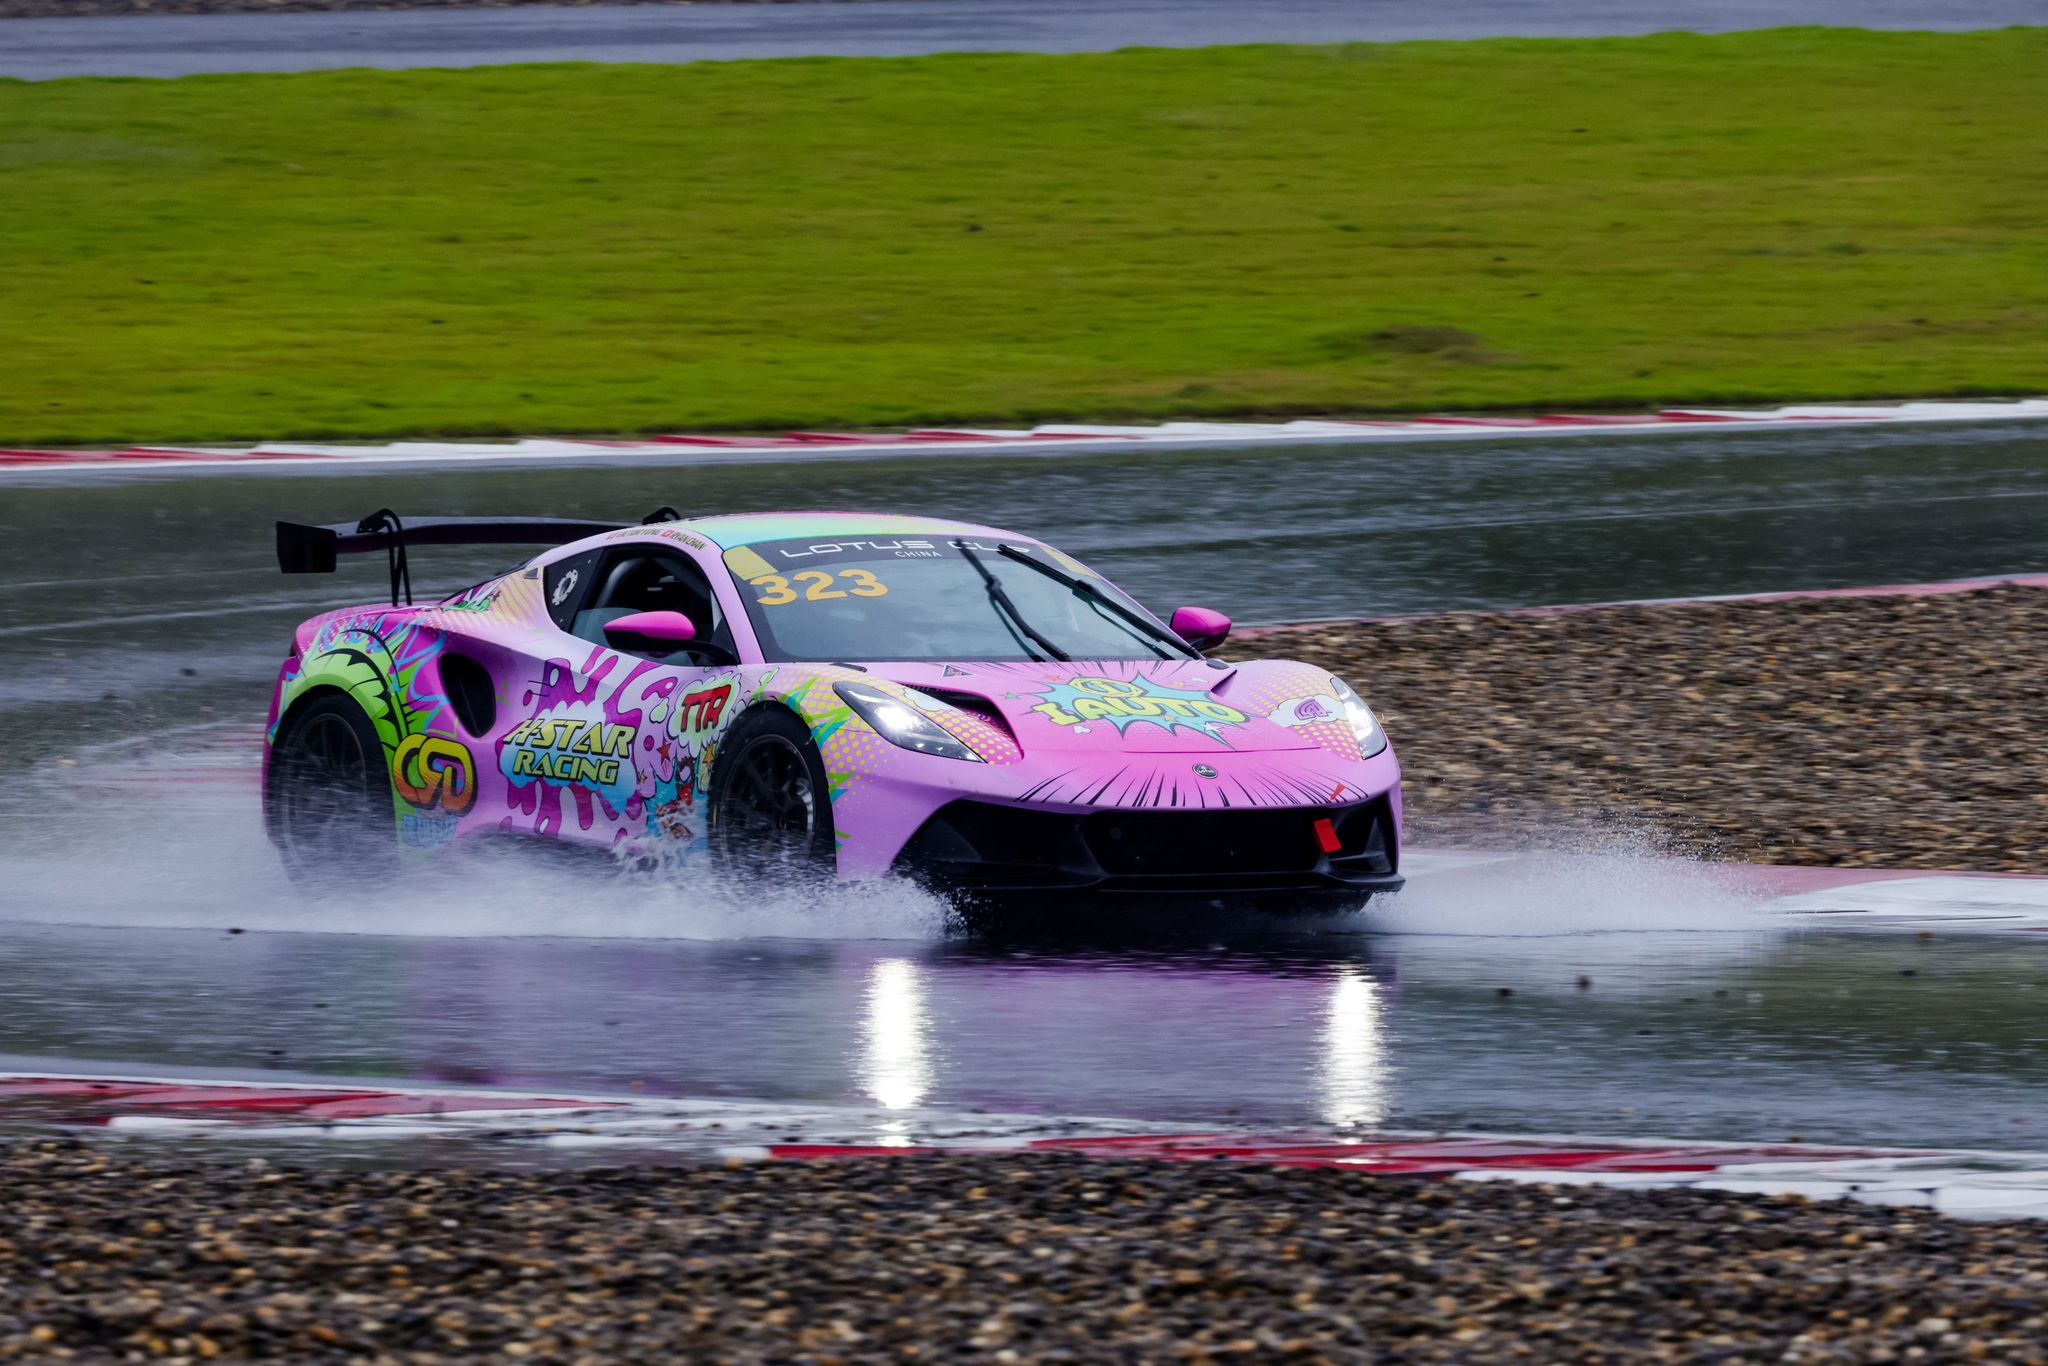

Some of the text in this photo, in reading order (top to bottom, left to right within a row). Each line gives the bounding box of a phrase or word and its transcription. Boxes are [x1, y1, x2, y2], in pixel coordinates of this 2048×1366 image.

[780, 540, 936, 558] LOTUS
[894, 550, 943, 559] CHINA
[750, 568, 889, 606] 323
[502, 718, 637, 760] H-STAR
[512, 749, 620, 786] RACING
